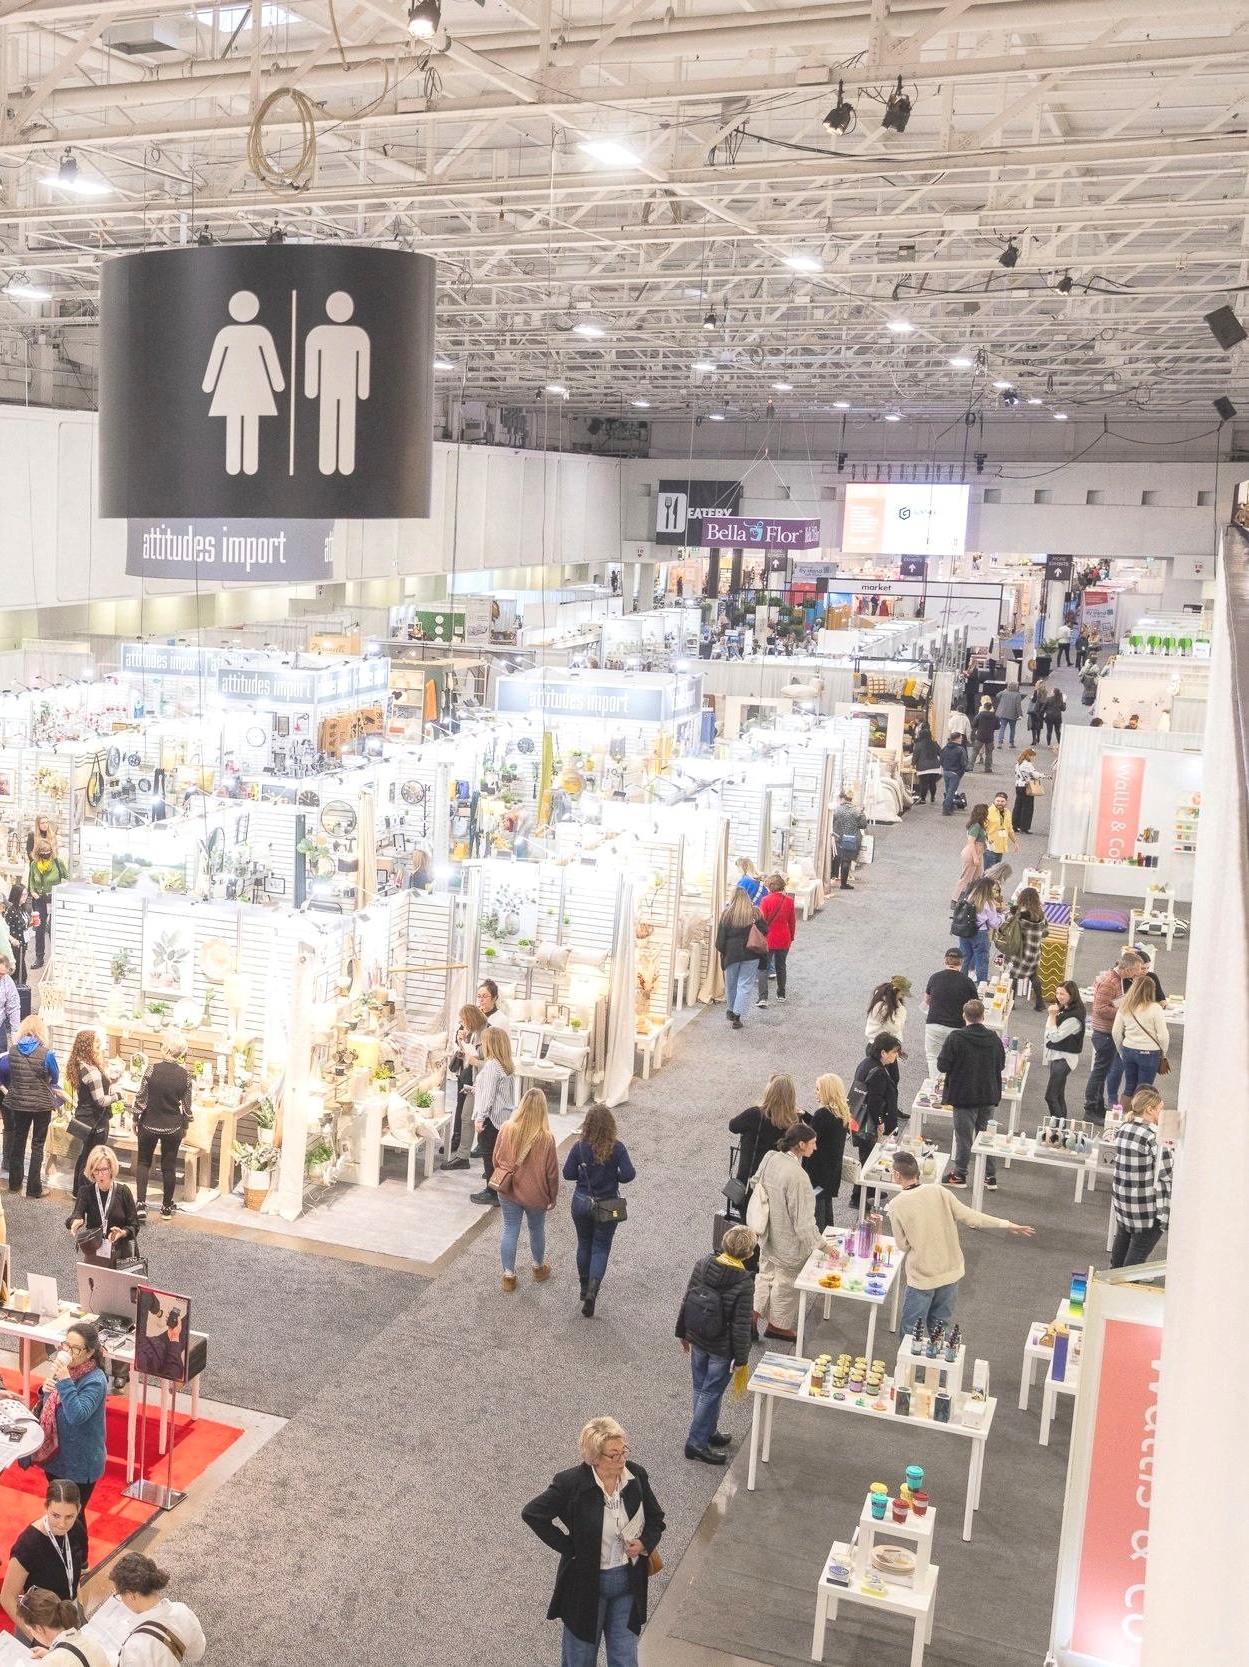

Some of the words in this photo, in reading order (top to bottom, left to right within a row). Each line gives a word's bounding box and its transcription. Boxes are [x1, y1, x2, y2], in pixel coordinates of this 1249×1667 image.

[687, 508, 732, 519] EATERY
[706, 523, 747, 541] Bella
[143, 525, 216, 563] attitudes
[222, 526, 287, 572] import
[170, 651, 203, 674] impor
[221, 671, 271, 695] attitudes
[274, 674, 312, 702] import
[529, 686, 584, 711] attitudes
[587, 690, 630, 718] import
[1112, 763, 1132, 816] Wallis
[1110, 820, 1128, 832] &
